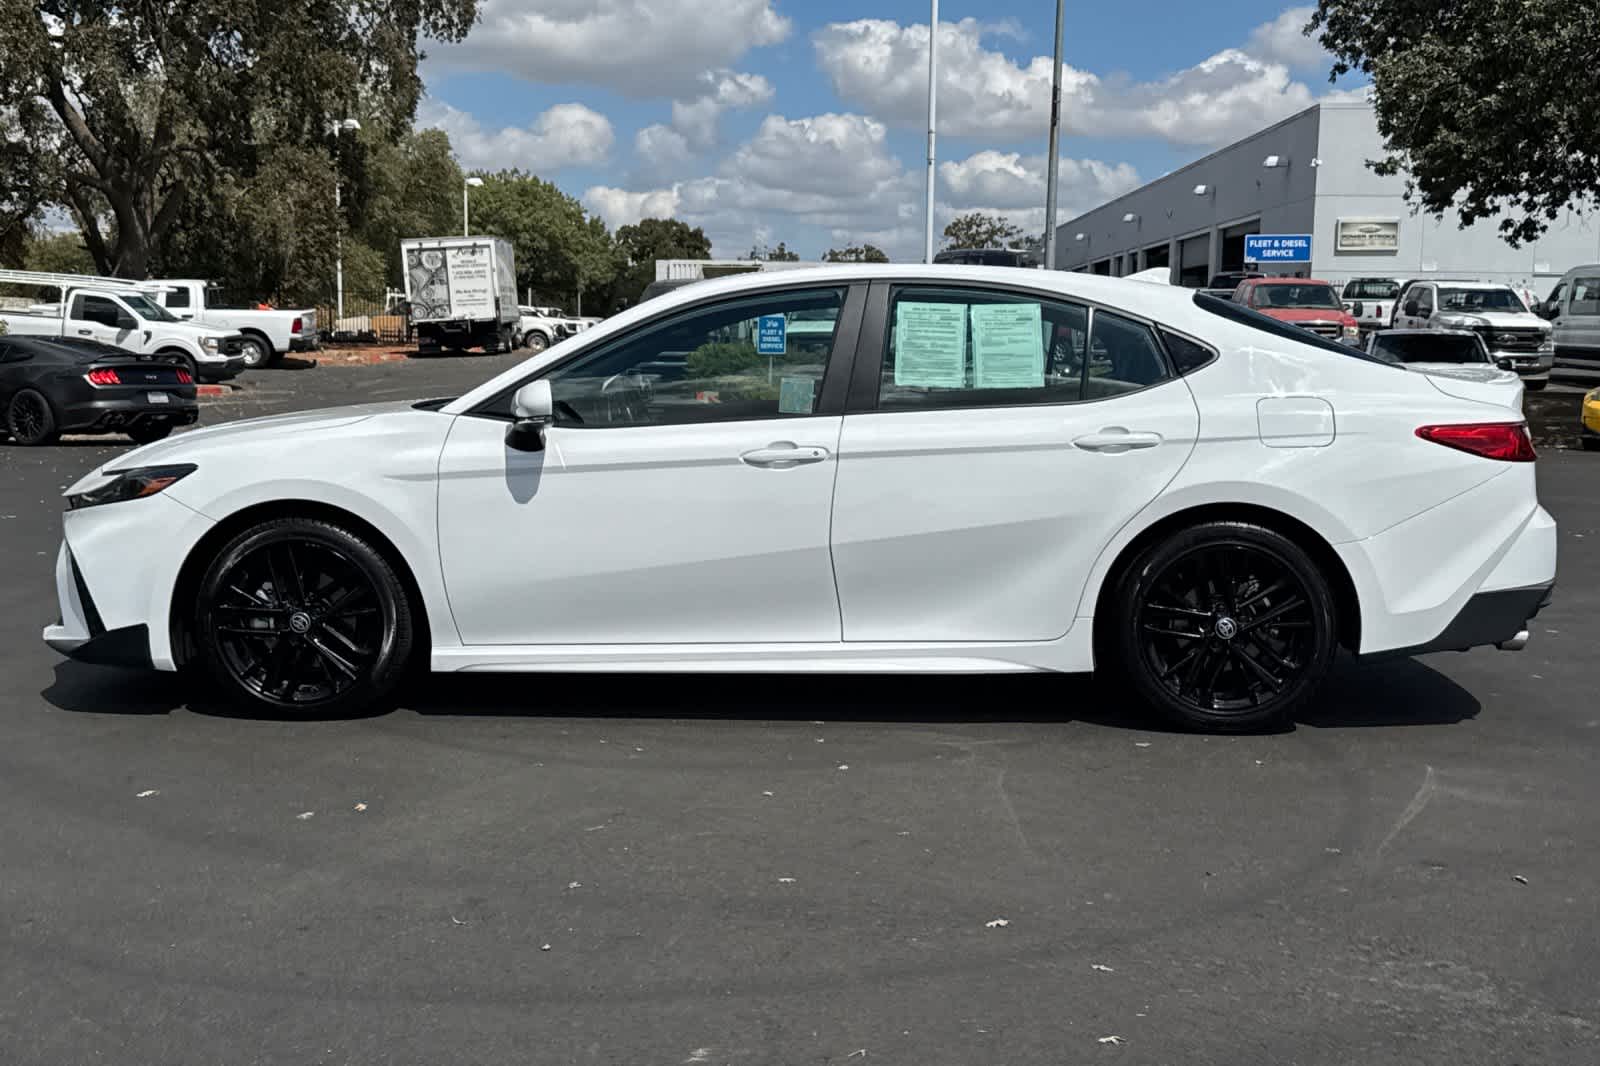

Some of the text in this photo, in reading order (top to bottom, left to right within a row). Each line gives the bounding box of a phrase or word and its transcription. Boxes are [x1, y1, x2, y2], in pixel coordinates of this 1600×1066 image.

[1249, 239, 1309, 248] FLEET & DIESEL
[1262, 249, 1294, 257] SERVICE
